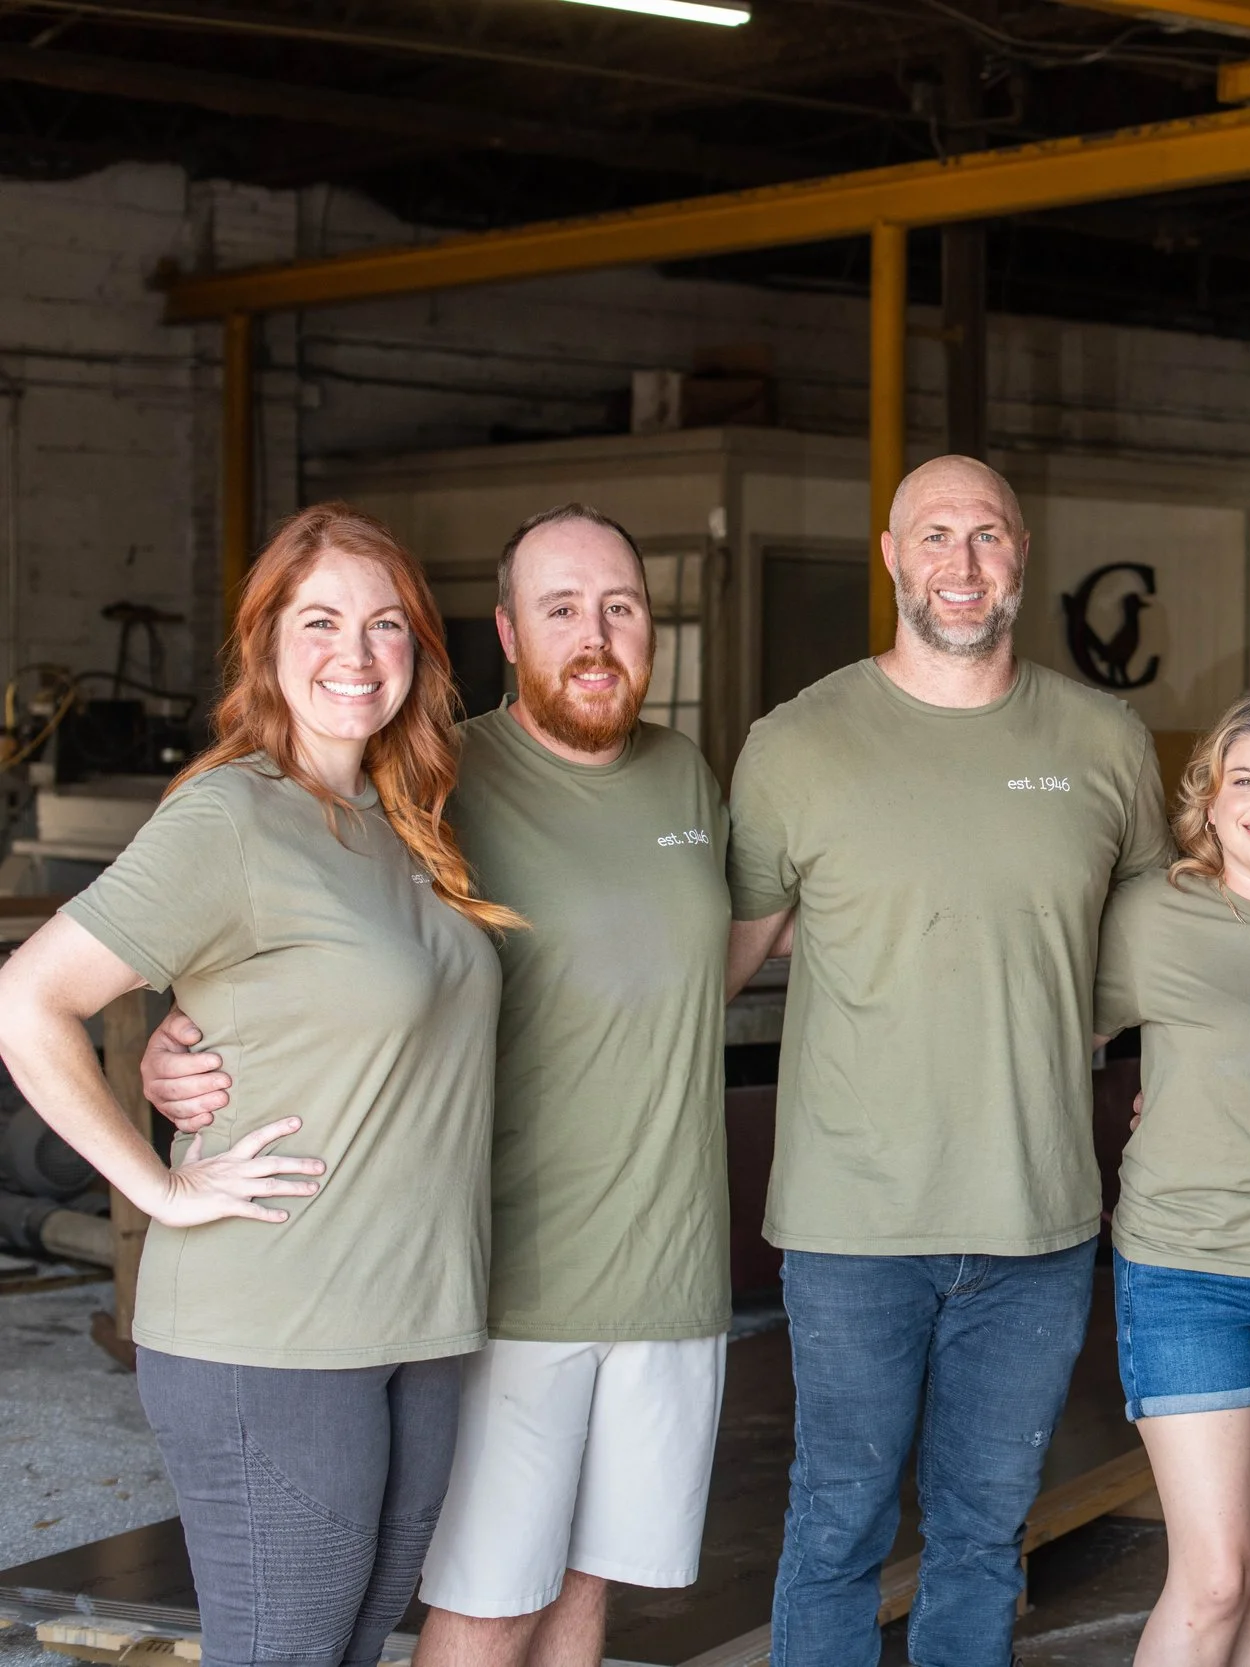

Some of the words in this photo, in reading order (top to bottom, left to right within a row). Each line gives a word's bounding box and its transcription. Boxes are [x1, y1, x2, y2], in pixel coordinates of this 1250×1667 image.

[1007, 776, 1036, 790] est.
[1039, 775, 1071, 792] 1946
[657, 832, 684, 847] est.
